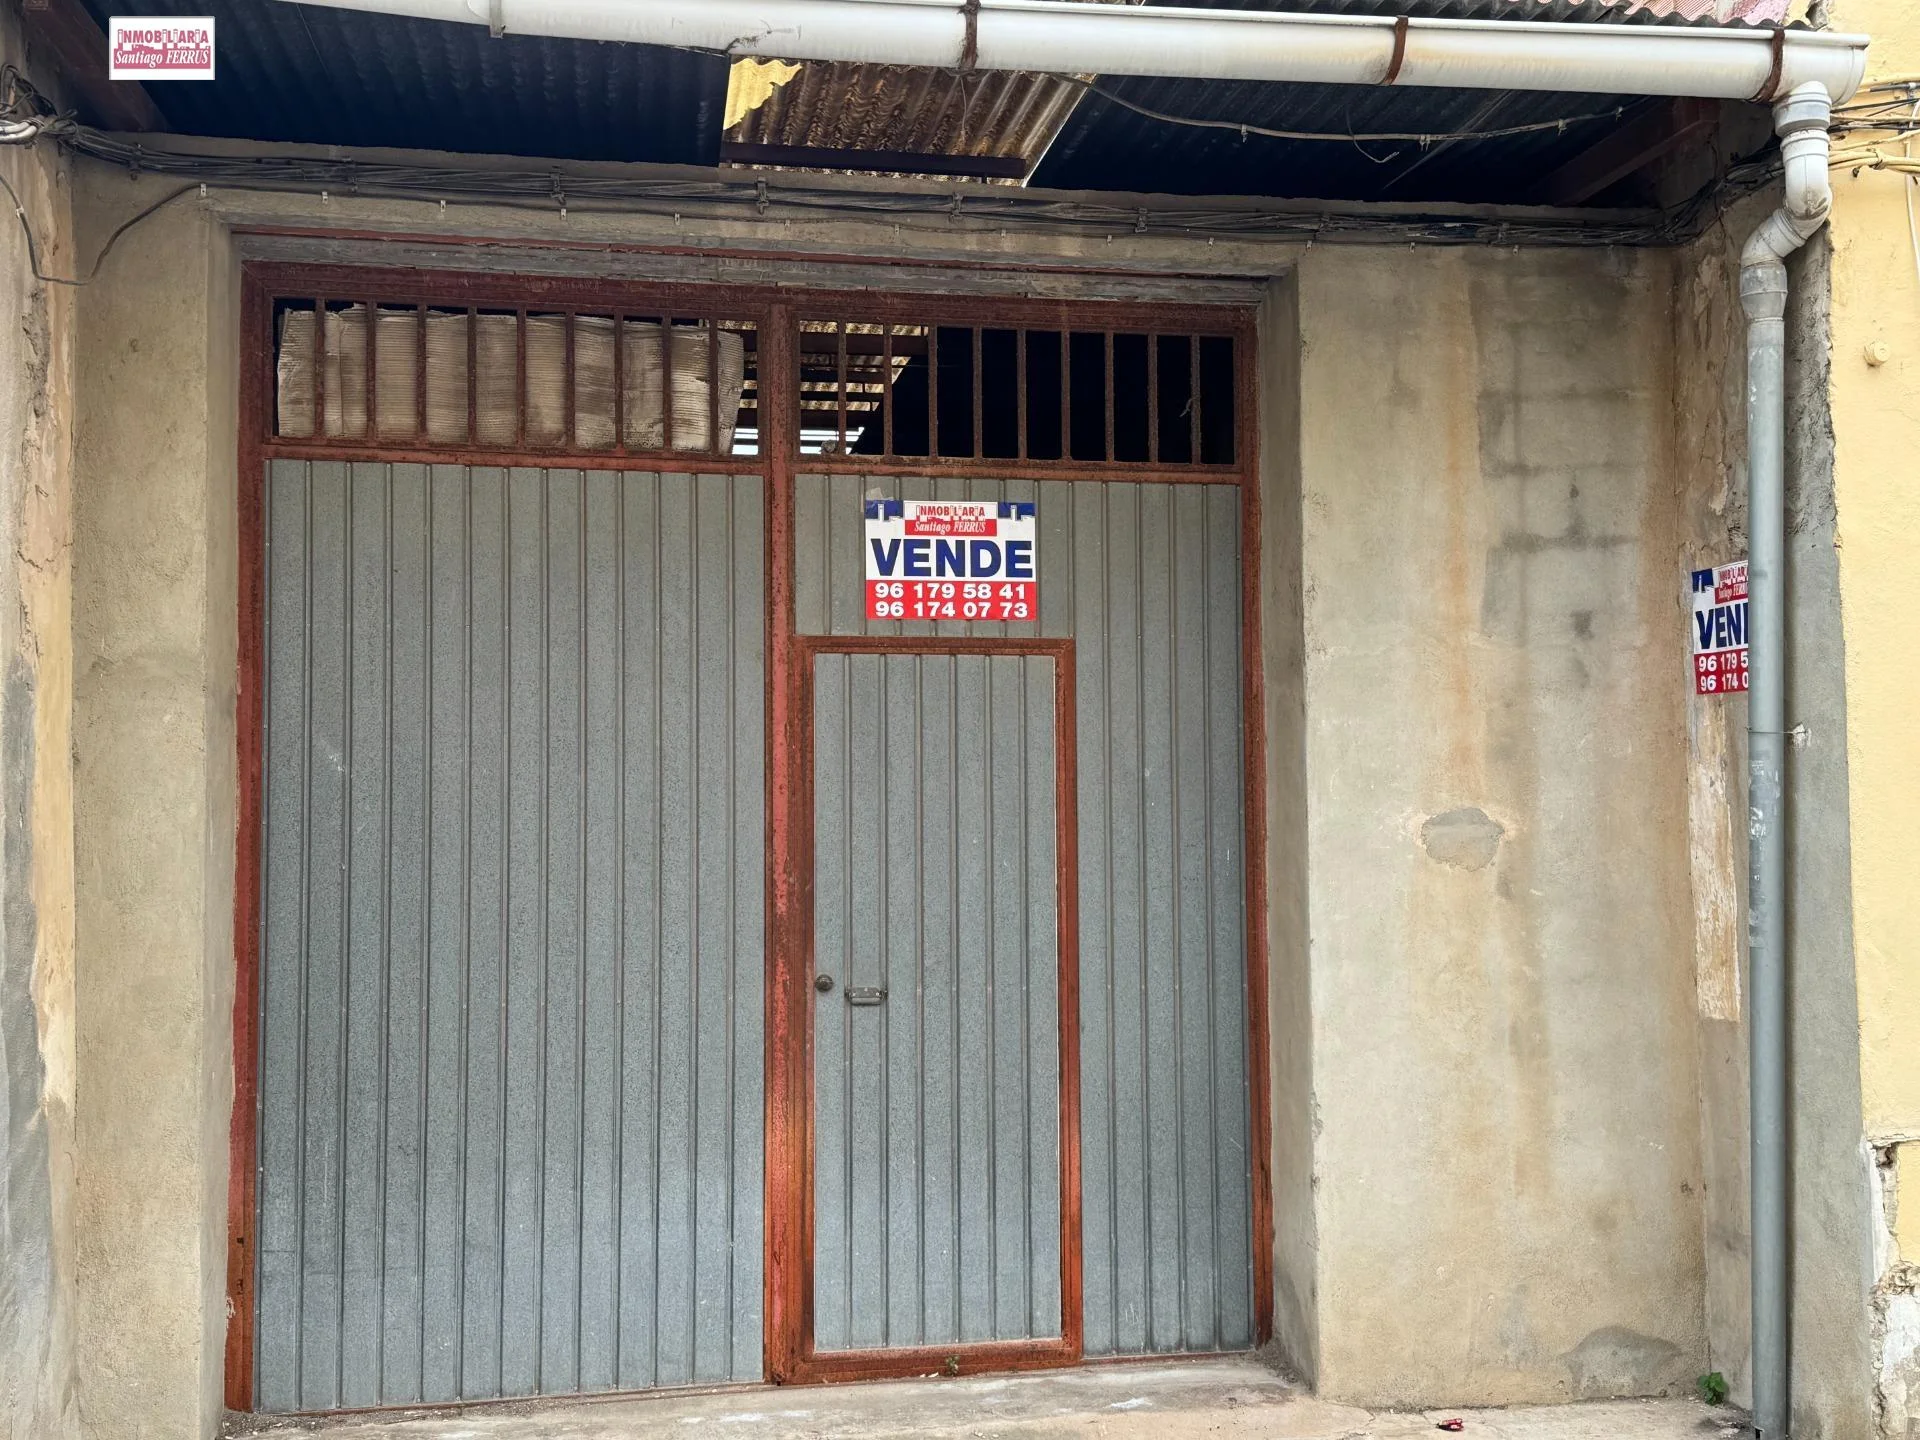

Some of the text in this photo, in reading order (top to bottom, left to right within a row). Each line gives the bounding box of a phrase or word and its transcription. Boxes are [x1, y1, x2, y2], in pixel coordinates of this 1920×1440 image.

[914, 521, 986, 535] Santiago FERRUS
[870, 538, 1033, 578] VENDE
[875, 582, 1025, 599] 96 179 58 41
[875, 601, 1028, 618] 96 174 07 73
[1699, 651, 1748, 672] 96 179 5
[1700, 671, 1748, 692] 96 174 0
